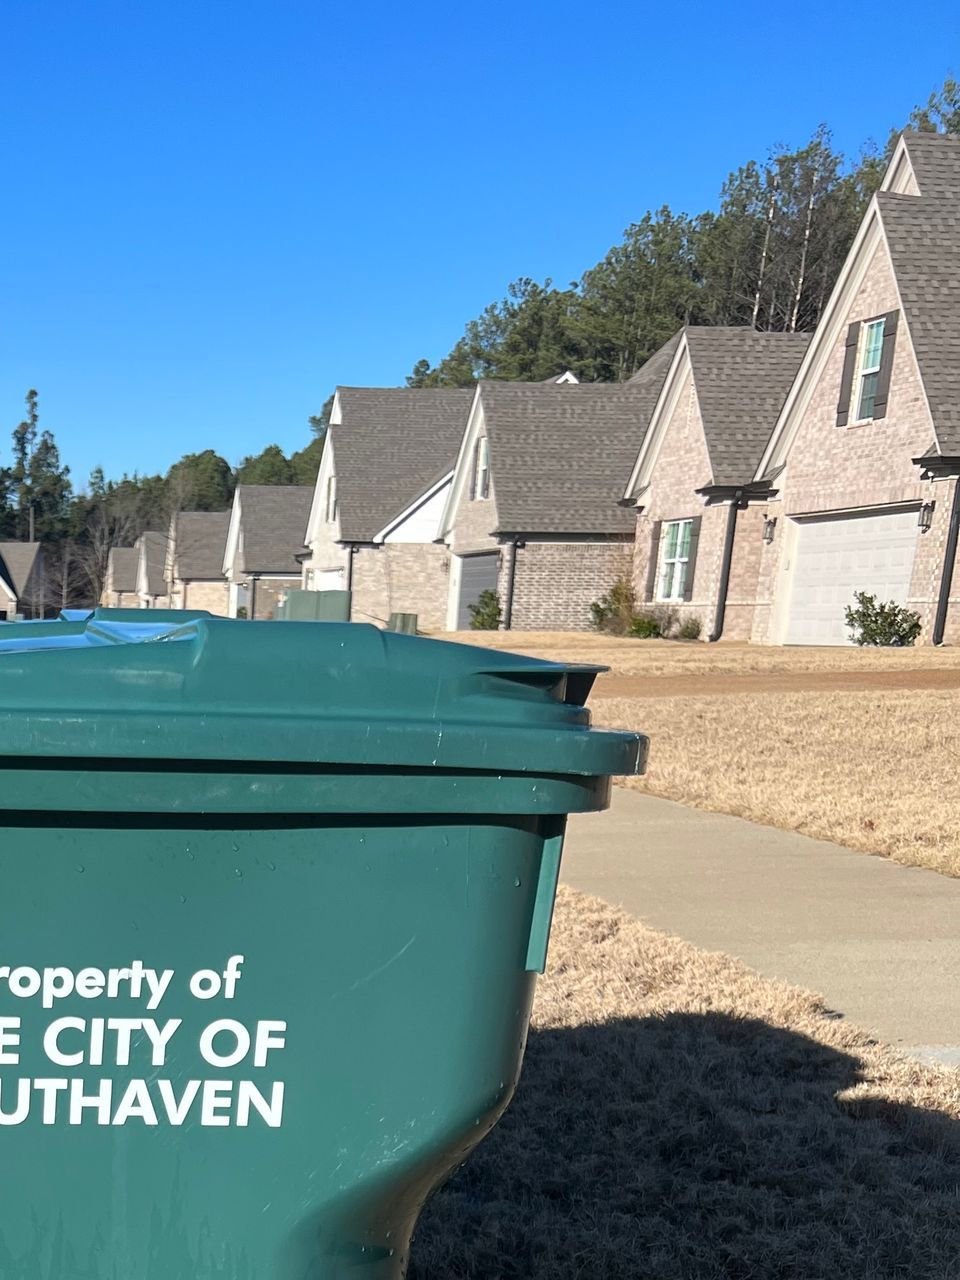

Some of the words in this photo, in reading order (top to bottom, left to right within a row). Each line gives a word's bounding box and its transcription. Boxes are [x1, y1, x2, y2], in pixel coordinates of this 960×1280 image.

[189, 954, 245, 1000] of
[42, 1015, 183, 1067] CITY
[198, 1018, 288, 1068] OF
